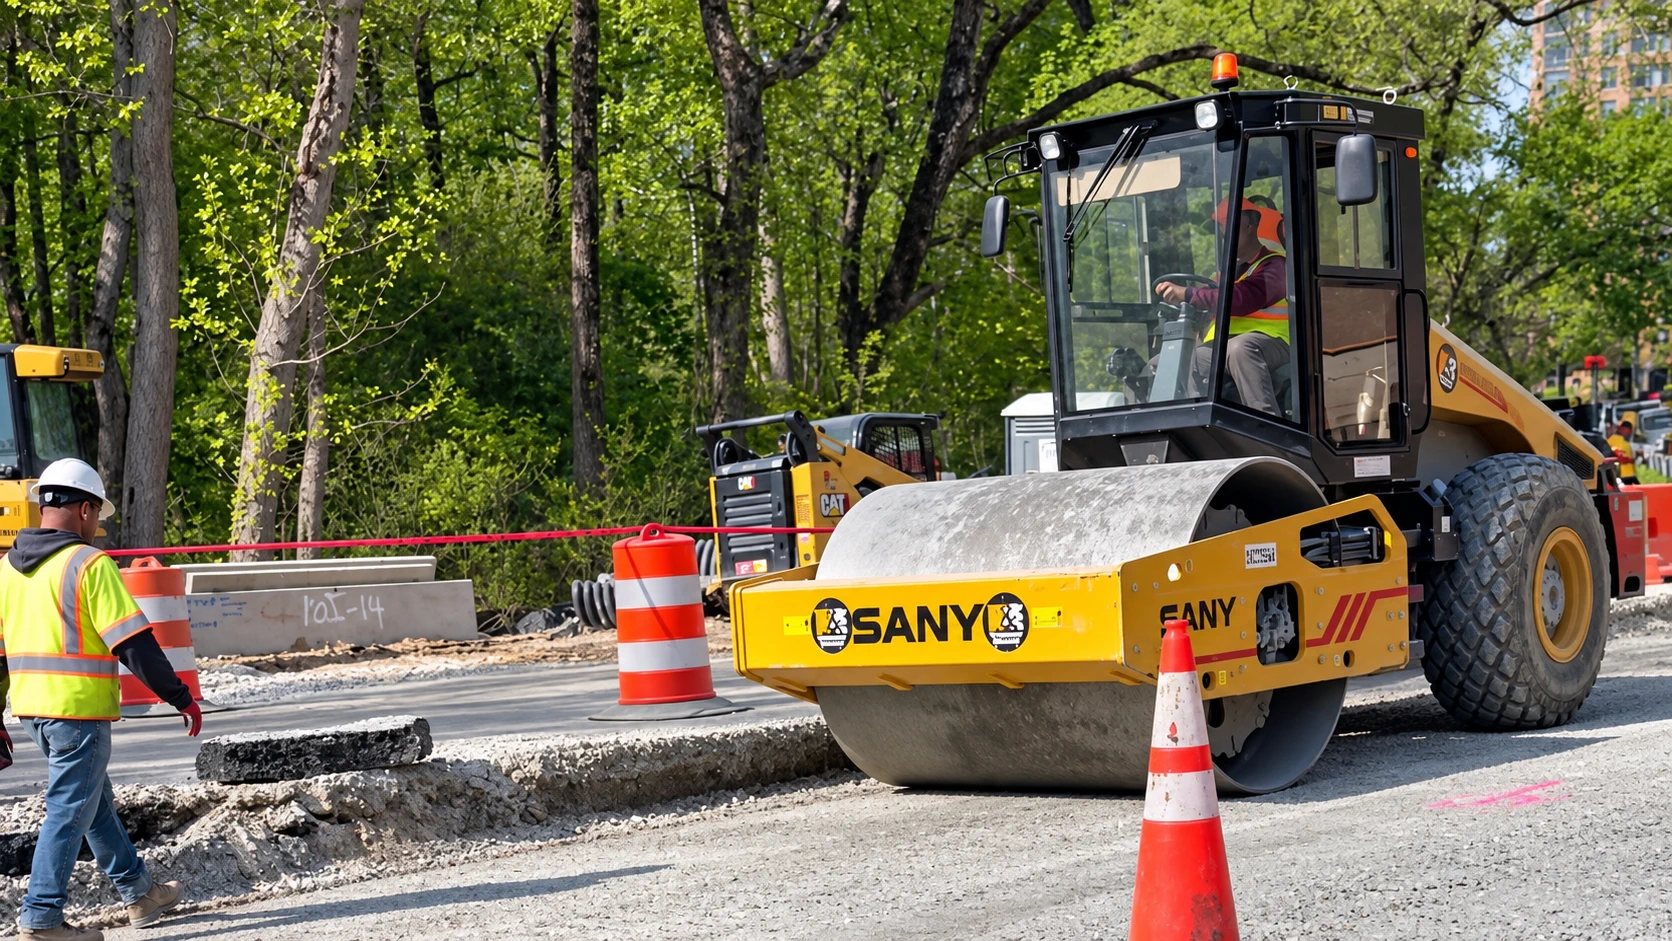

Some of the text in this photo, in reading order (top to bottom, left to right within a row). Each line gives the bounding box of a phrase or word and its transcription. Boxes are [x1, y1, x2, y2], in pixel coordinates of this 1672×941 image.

[738, 476, 753, 490] CAT
[821, 494, 845, 516] CAT
[852, 604, 984, 644] SANY
